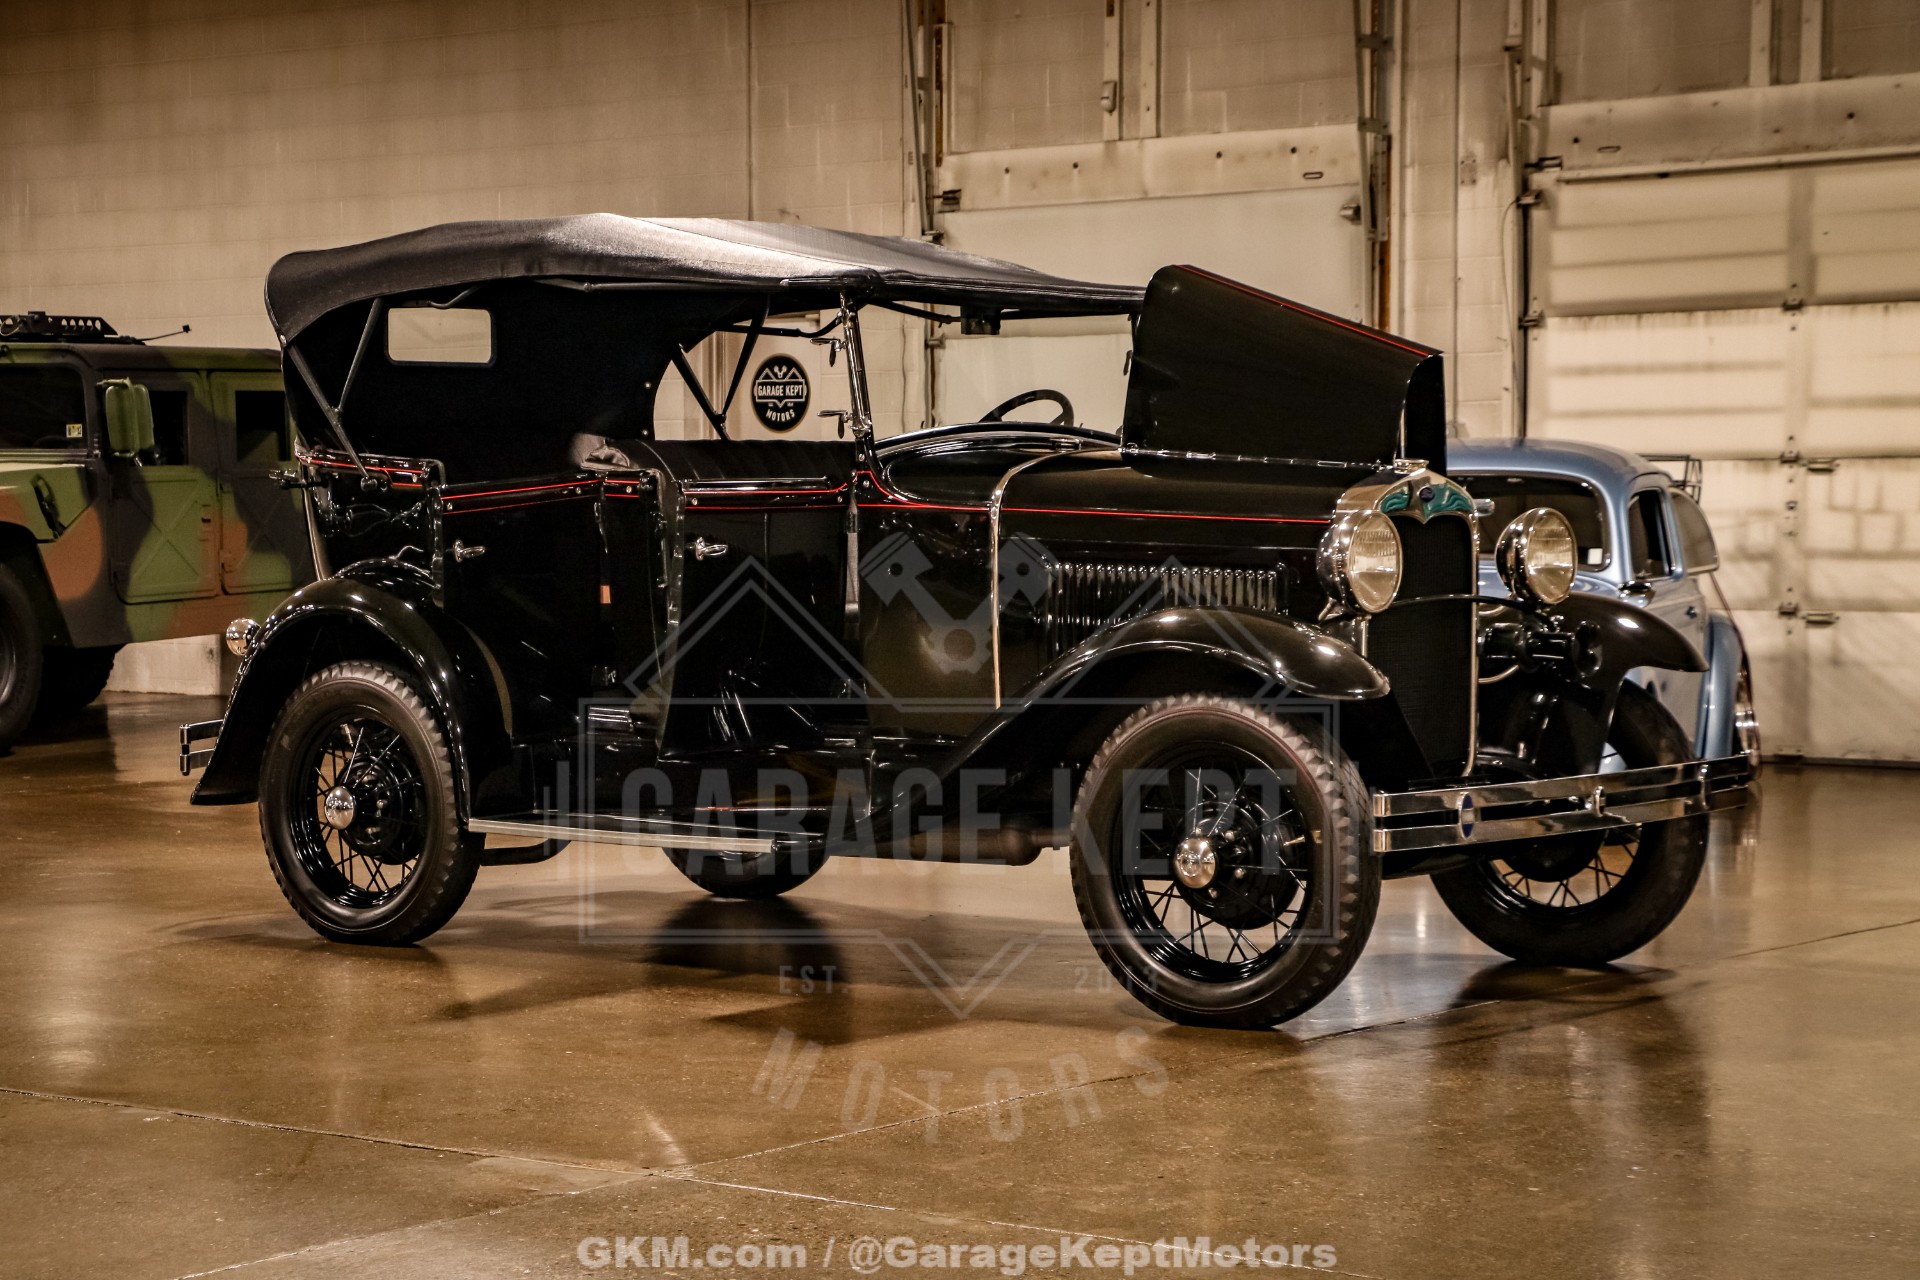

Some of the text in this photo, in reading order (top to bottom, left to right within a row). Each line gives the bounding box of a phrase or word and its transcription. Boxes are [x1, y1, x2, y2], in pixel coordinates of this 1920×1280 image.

[758, 385, 803, 396] GARAGE KEPT
[766, 408, 796, 422] MOTORS
